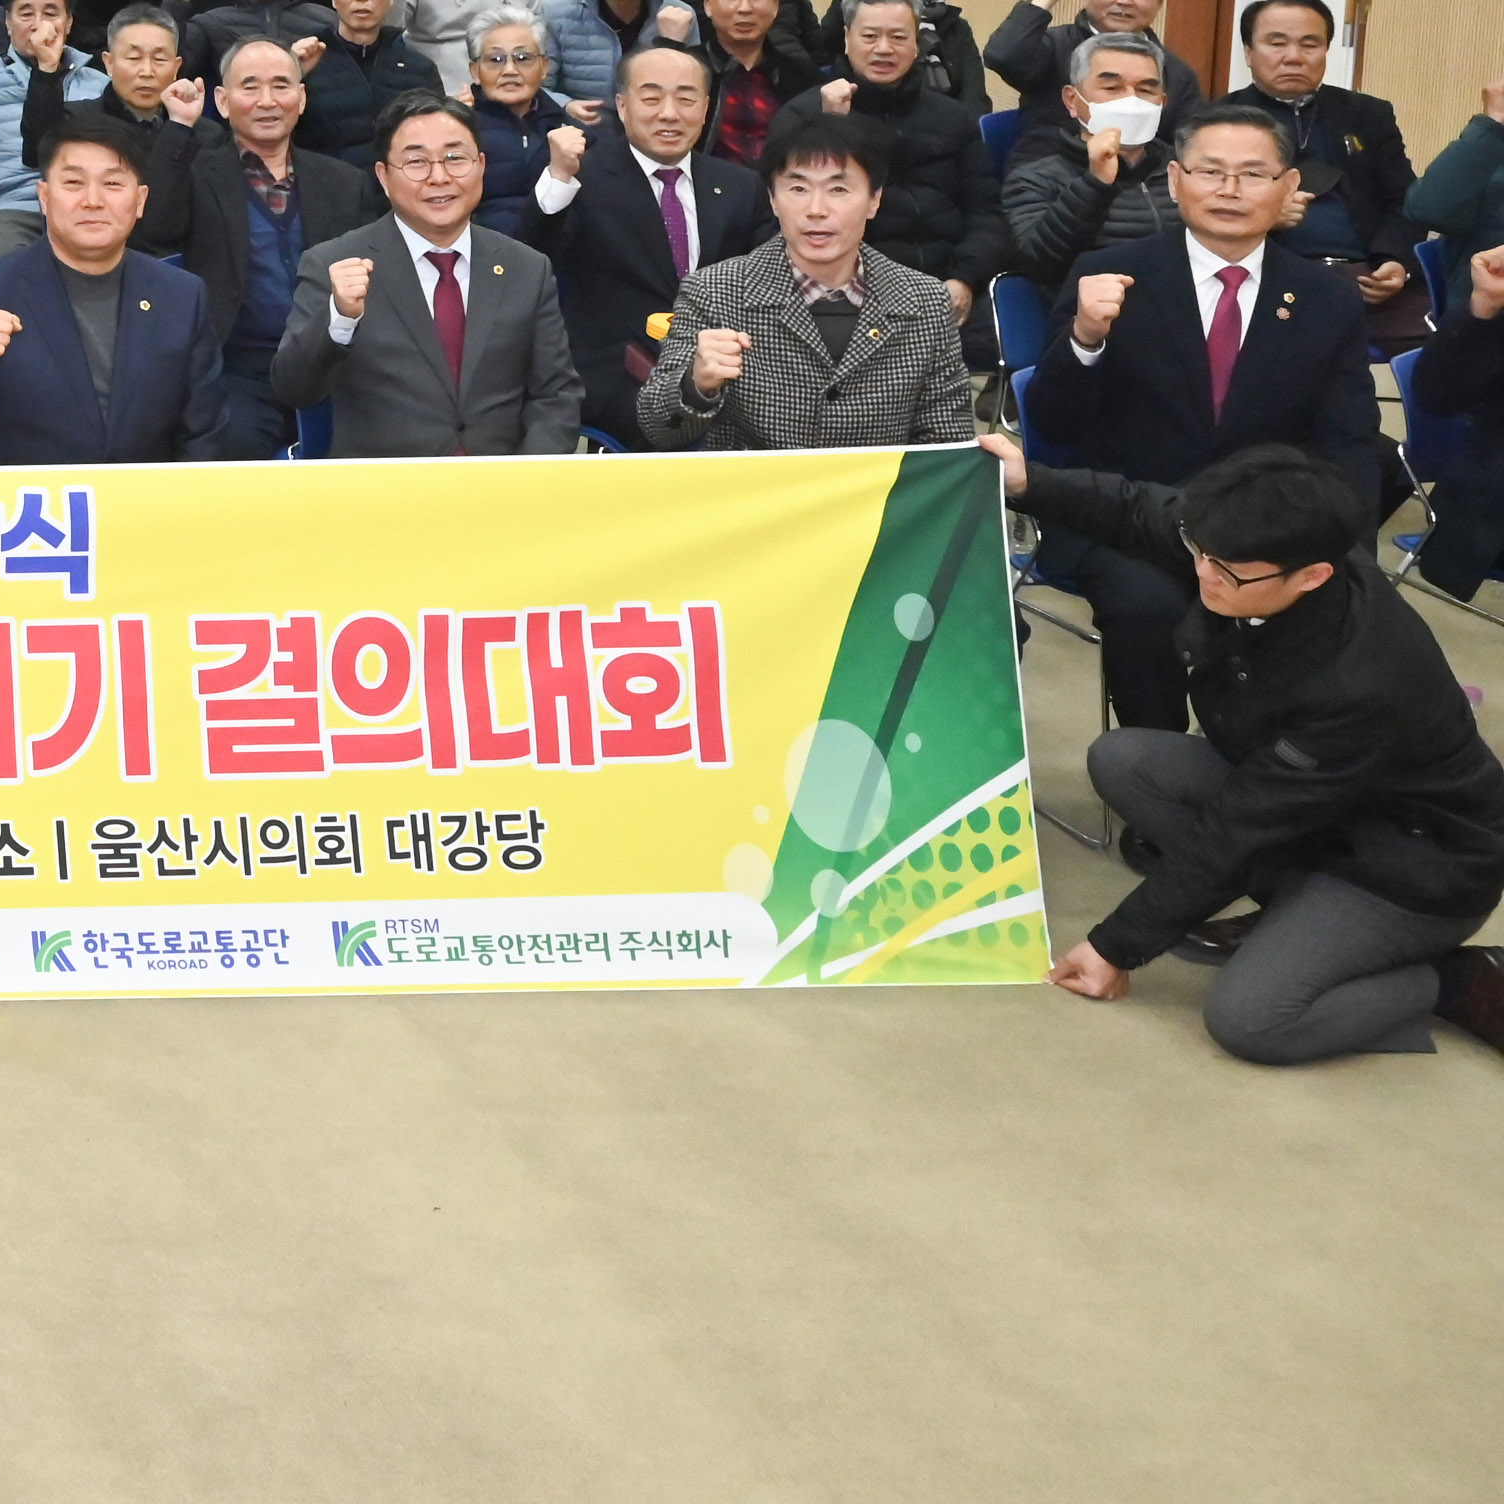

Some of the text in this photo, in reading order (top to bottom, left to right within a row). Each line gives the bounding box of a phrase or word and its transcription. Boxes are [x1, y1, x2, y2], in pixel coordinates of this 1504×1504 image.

[196, 607, 726, 773] 결의대회
[92, 815, 361, 878] 울산시의회
[387, 810, 544, 871] 대강당
[384, 919, 440, 935] RTSM
[82, 929, 290, 970] 한국도로교통공단
[147, 958, 209, 971] KOROAD
[386, 929, 732, 966] 도로교통안전관리 주식회사
